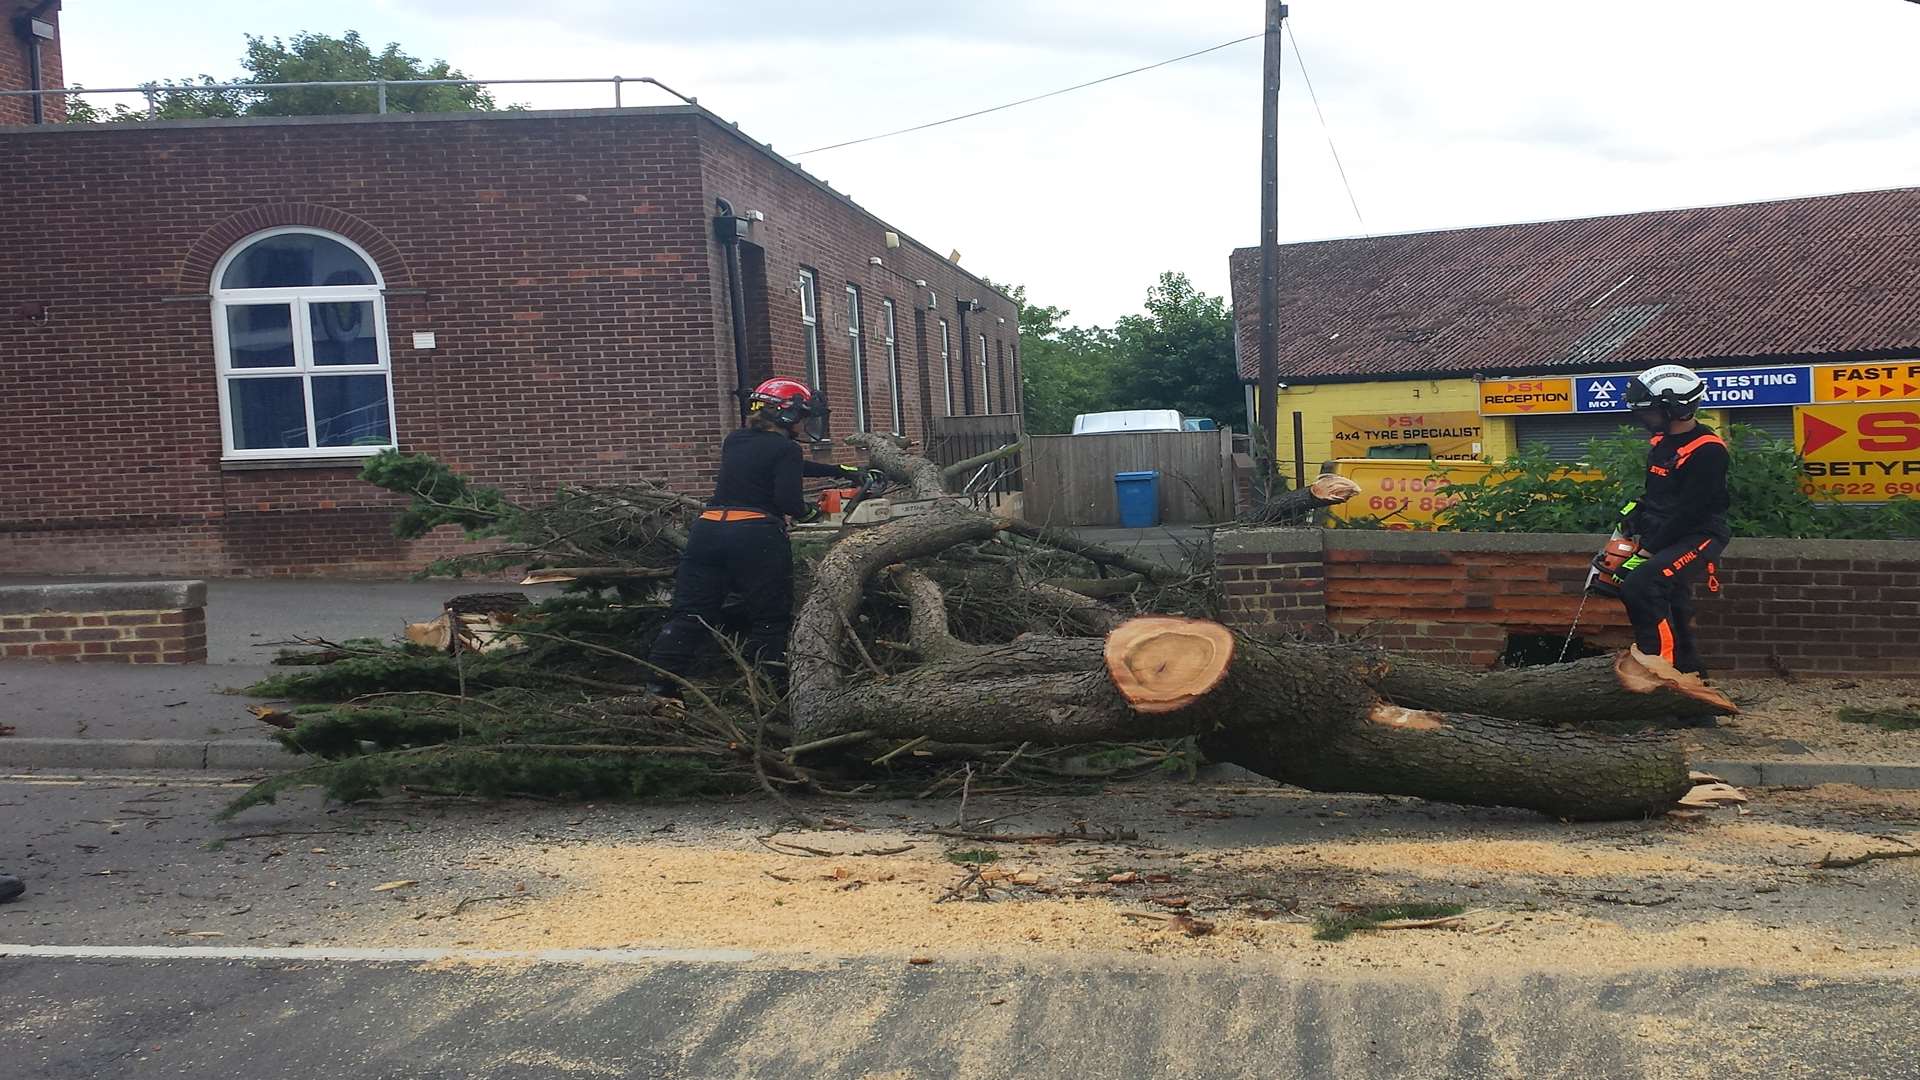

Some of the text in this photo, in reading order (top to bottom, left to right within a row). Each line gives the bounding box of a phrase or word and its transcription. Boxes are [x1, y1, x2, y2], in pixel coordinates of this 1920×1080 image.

[1713, 374, 1797, 387] TESTING
[1833, 367, 1898, 381] FAST
[1518, 383, 1532, 391] S
[1484, 393, 1568, 404] RECEPTION
[1700, 389, 1754, 401] ATION
[1335, 427, 1481, 441] 4x4 TYRE SPECIALIST
[1857, 411, 1920, 452] S
[1673, 551, 1697, 570] STIHL
